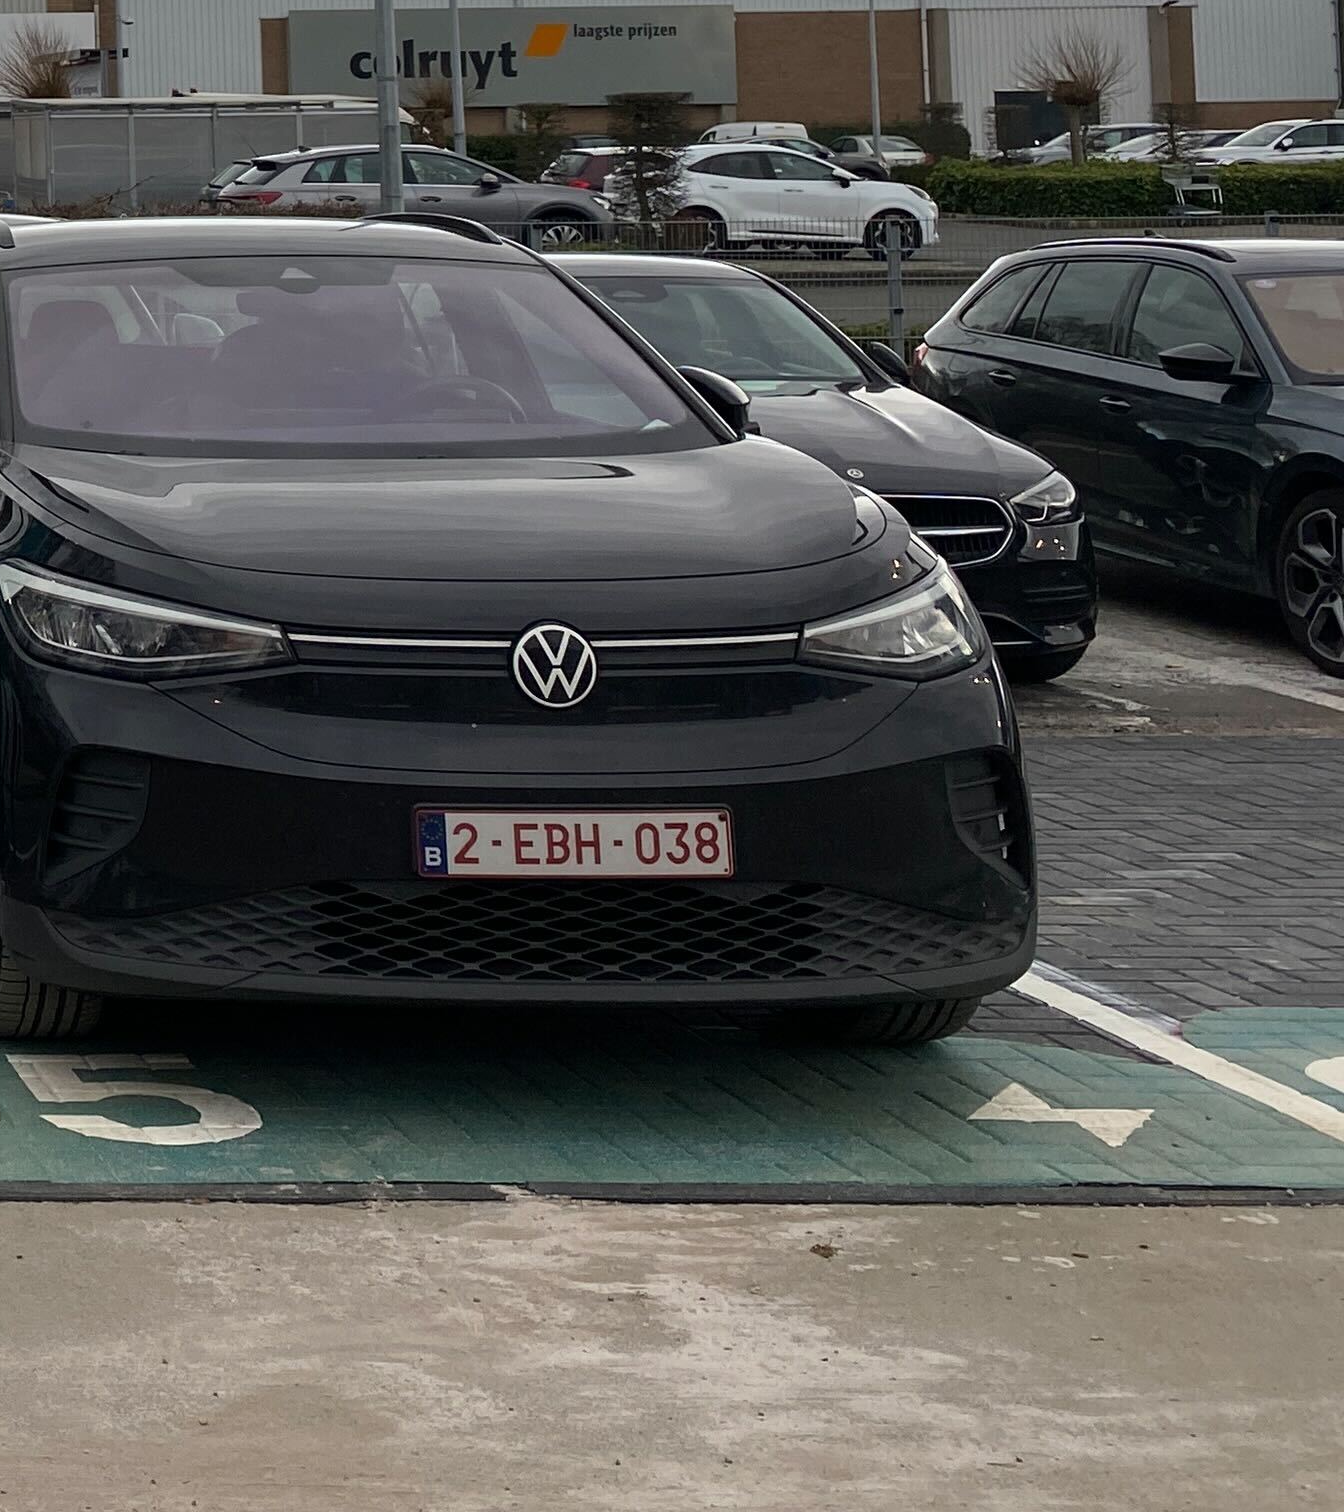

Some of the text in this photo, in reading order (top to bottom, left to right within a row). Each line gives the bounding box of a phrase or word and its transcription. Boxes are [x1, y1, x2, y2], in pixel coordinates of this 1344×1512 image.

[573, 23, 677, 40] laagste prijzen
[453, 822, 720, 865] 2-EBH-038
[424, 847, 442, 867] B
